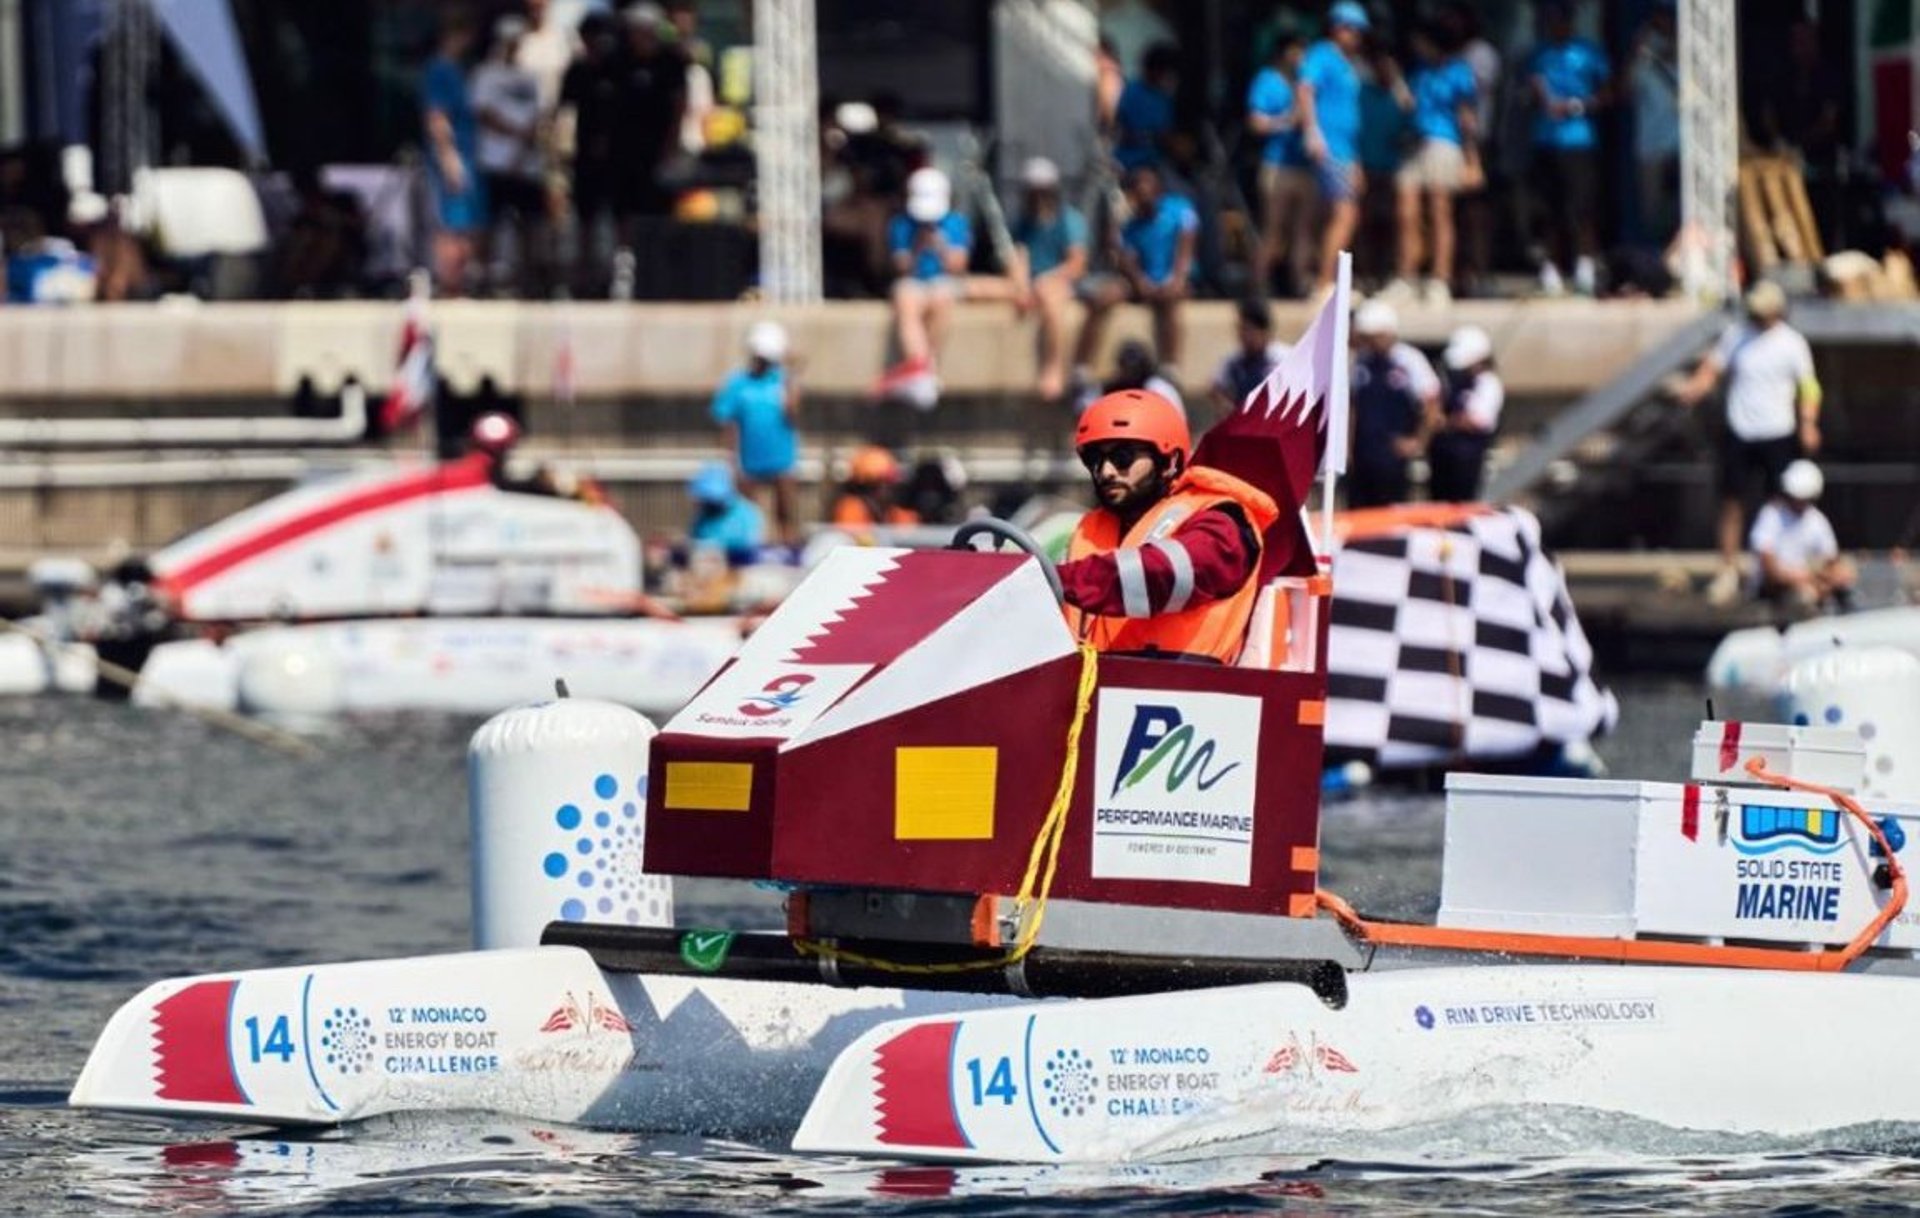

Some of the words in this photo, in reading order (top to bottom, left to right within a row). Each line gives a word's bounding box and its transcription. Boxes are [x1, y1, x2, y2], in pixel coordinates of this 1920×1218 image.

[1097, 808, 1198, 828] PERFORMANCE
[1201, 813, 1254, 833] MARINE
[1737, 859, 1785, 879] SOLID
[1788, 860, 1842, 881] STATE
[1735, 883, 1841, 922] MARINE
[411, 1007, 487, 1023] MONACO
[1445, 1006, 1478, 1025] RIM
[1482, 1004, 1535, 1023] DRIVE
[1537, 1002, 1656, 1022] TECHNOLOGY
[244, 1014, 296, 1064] 14
[385, 1031, 449, 1049] ENERGY
[454, 1031, 498, 1048] BOAT
[385, 1055, 499, 1073] CHALLENGE
[1135, 1047, 1210, 1064] MONACO
[966, 1055, 1018, 1107] 14
[1107, 1073, 1169, 1091] ENERGY
[1176, 1072, 1220, 1090] BOAT
